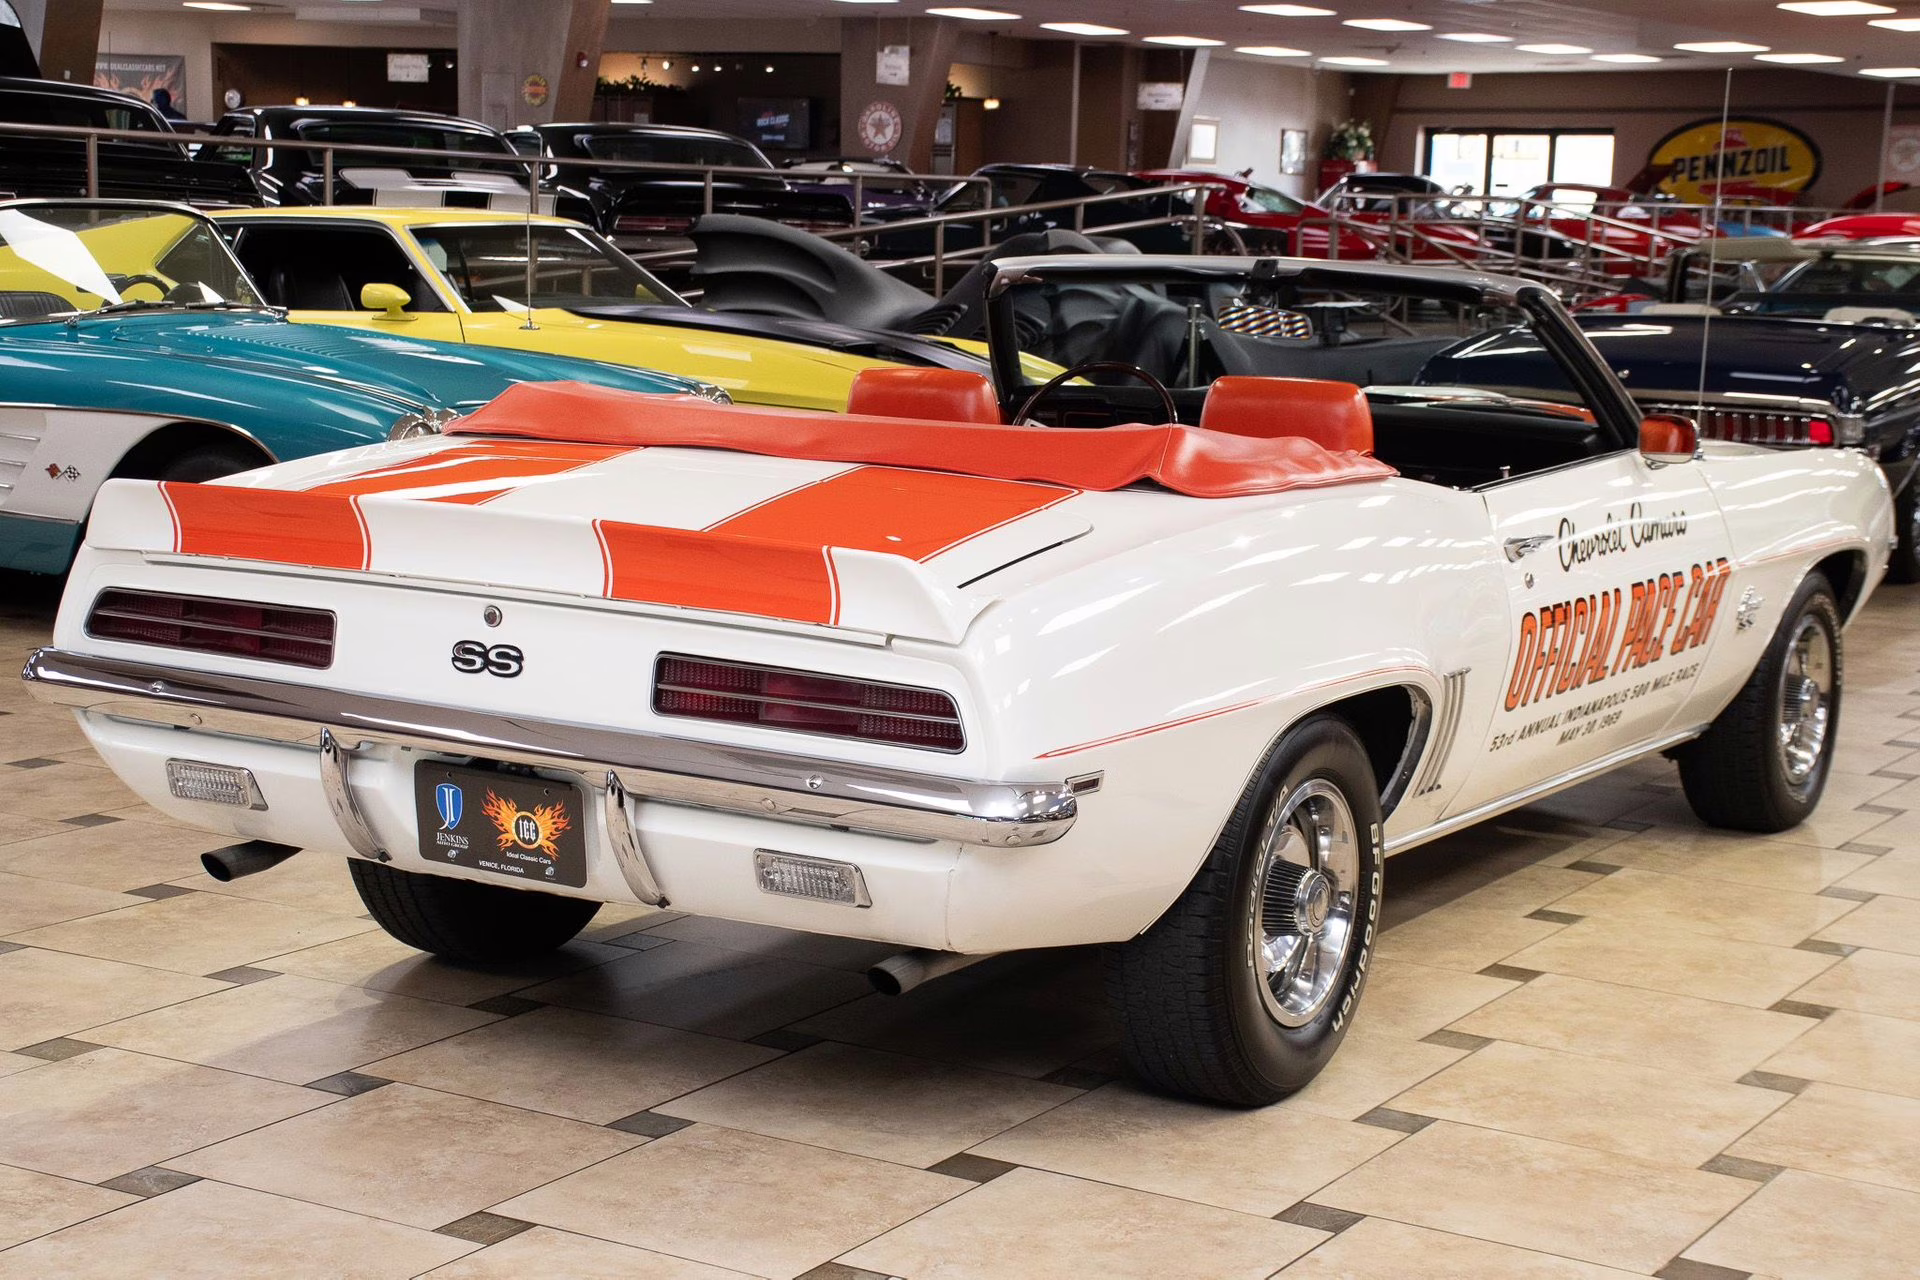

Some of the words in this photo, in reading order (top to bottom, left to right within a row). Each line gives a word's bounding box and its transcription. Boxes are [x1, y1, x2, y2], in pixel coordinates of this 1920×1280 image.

[1670, 146, 1791, 183] PENNZOIL
[1558, 512, 1627, 572] Chevrolet
[1630, 502, 1687, 548] Camaro
[1504, 588, 1622, 712] OFFICIAL
[1610, 571, 1684, 677] PACE
[1670, 557, 1731, 655] CAR
[451, 640, 524, 678] SS
[1489, 731, 1517, 752] 53rd
[1517, 712, 1559, 741] ANNUAL
[1562, 688, 1630, 725] INDIANAPOLIS
[1630, 682, 1650, 700] 500
[1651, 671, 1675, 692] MILE
[1675, 662, 1700, 682] RACE
[1556, 728, 1582, 746] MAY
[1599, 710, 1623, 731] 1969
[436, 832, 469, 845] JENKINS
[501, 864, 524, 874] FLORIDA
[506, 851, 519, 859] Ideal
[520, 854, 538, 862] Classic
[539, 857, 551, 865] Cars
